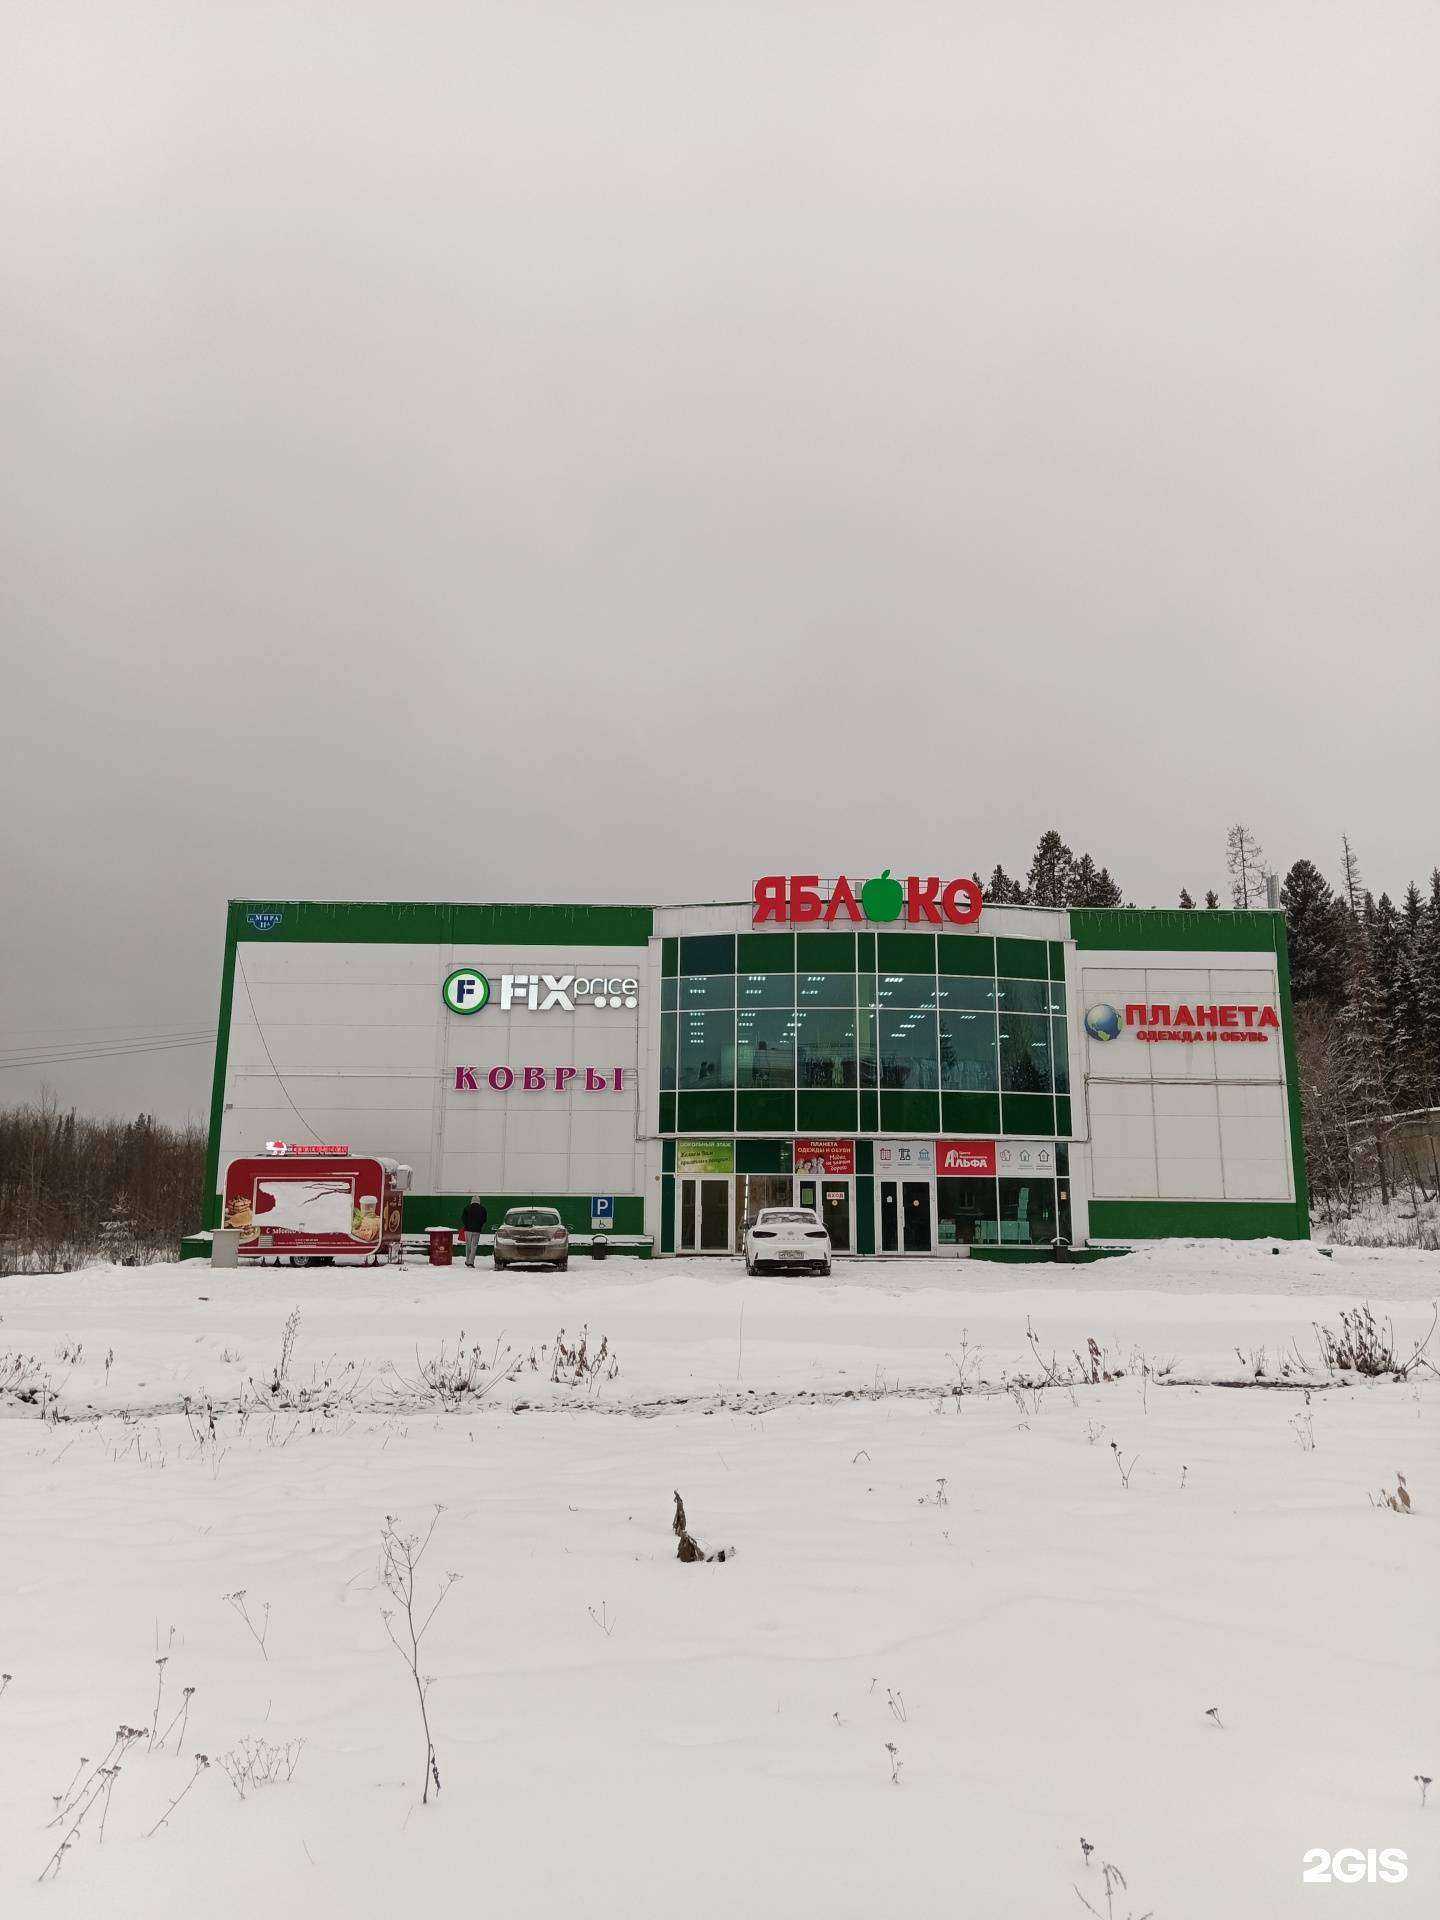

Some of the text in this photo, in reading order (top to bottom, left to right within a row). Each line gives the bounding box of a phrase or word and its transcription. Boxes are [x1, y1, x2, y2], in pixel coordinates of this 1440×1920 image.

[1125, 1004, 1280, 1027] ПЛАНЕТА
[1136, 1031, 1269, 1043] ОДЕЖДА И ОБУВЬ
[454, 1065, 625, 1092] КОВРЫ
